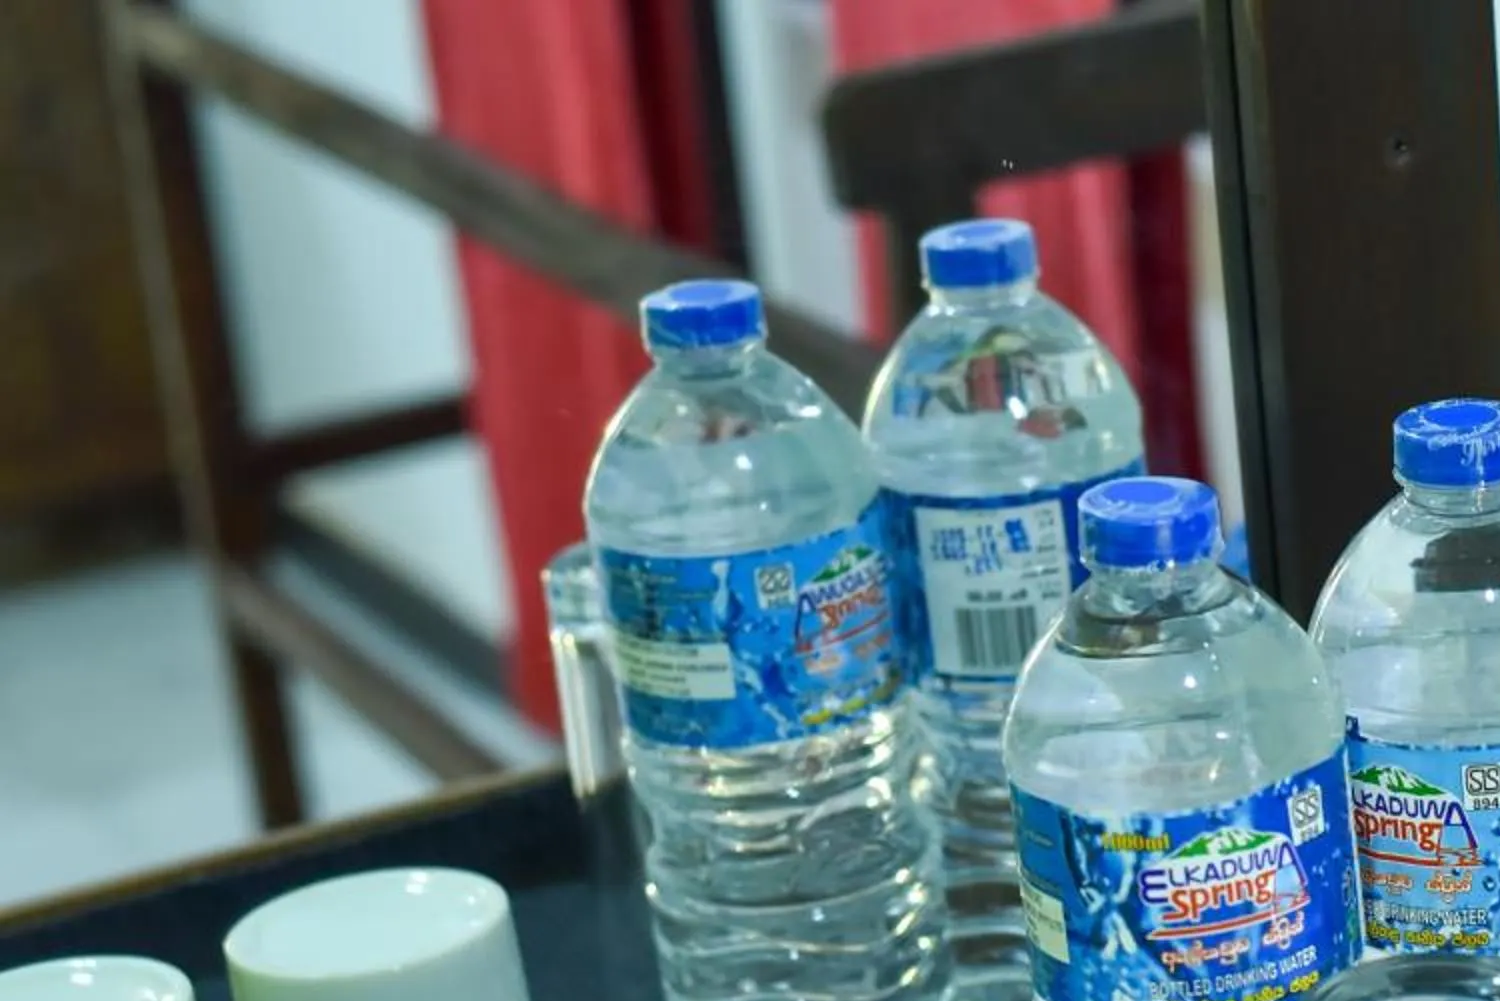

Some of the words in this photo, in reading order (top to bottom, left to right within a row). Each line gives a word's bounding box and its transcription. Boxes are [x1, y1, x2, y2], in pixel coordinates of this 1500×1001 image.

[1352, 787, 1478, 849] LKADUWA
[1140, 842, 1307, 903] ELKADUWA
[1163, 870, 1277, 920] Spring
[1150, 980, 1212, 1001] BOTTLED
[1216, 962, 1277, 992] DRINKING
[1280, 945, 1317, 974] WATER
